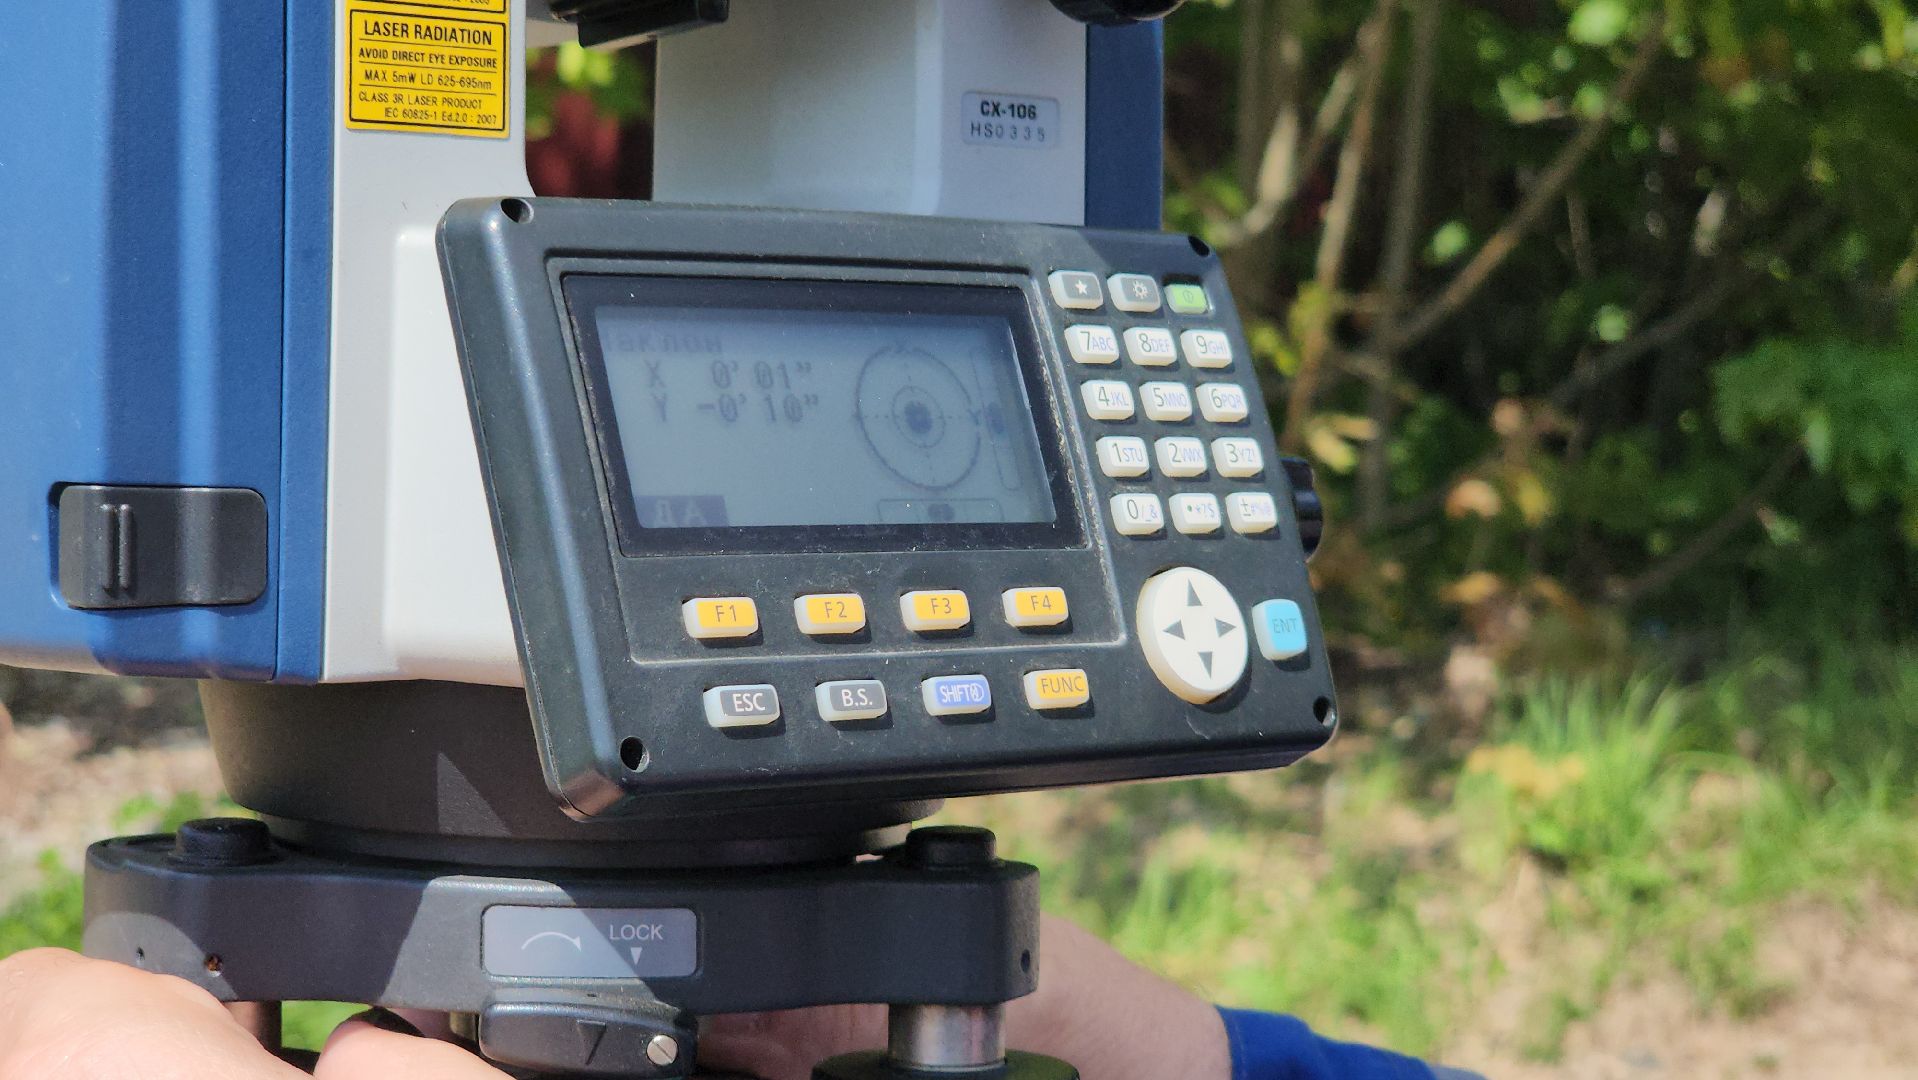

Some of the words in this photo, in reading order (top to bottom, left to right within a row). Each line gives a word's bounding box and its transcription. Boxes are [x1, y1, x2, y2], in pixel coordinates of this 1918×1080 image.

[364, 20, 409, 39] LASER
[414, 24, 492, 46] RADIATION
[358, 47, 388, 60] AVOID
[392, 51, 425, 63] DIRECT
[429, 54, 446, 65] EYE
[449, 56, 497, 69] EXPOSURE
[364, 70, 387, 82] MAX
[392, 72, 416, 84] 5mW
[420, 74, 434, 84] LD
[438, 76, 492, 90] 625-695nm
[358, 91, 389, 103] CLASS
[393, 94, 404, 105] 3R
[408, 95, 438, 106] LASER
[442, 99, 482, 109] PRODUCT
[980, 100, 1037, 119] CX-106
[384, 107, 399, 118] IEC
[402, 109, 438, 120] 60825-1
[476, 114, 497, 125] 2007
[644, 359, 667, 387] X
[650, 392, 669, 422] Y
[825, 600, 848, 618] F2
[931, 596, 953, 614] F3
[1030, 593, 1052, 611] F4
[715, 604, 738, 622] F1
[1272, 618, 1298, 634] ENT
[1041, 674, 1085, 695] FUNC
[732, 693, 766, 713] ESC
[841, 689, 873, 708] B.S.
[609, 924, 664, 940] LOCK
